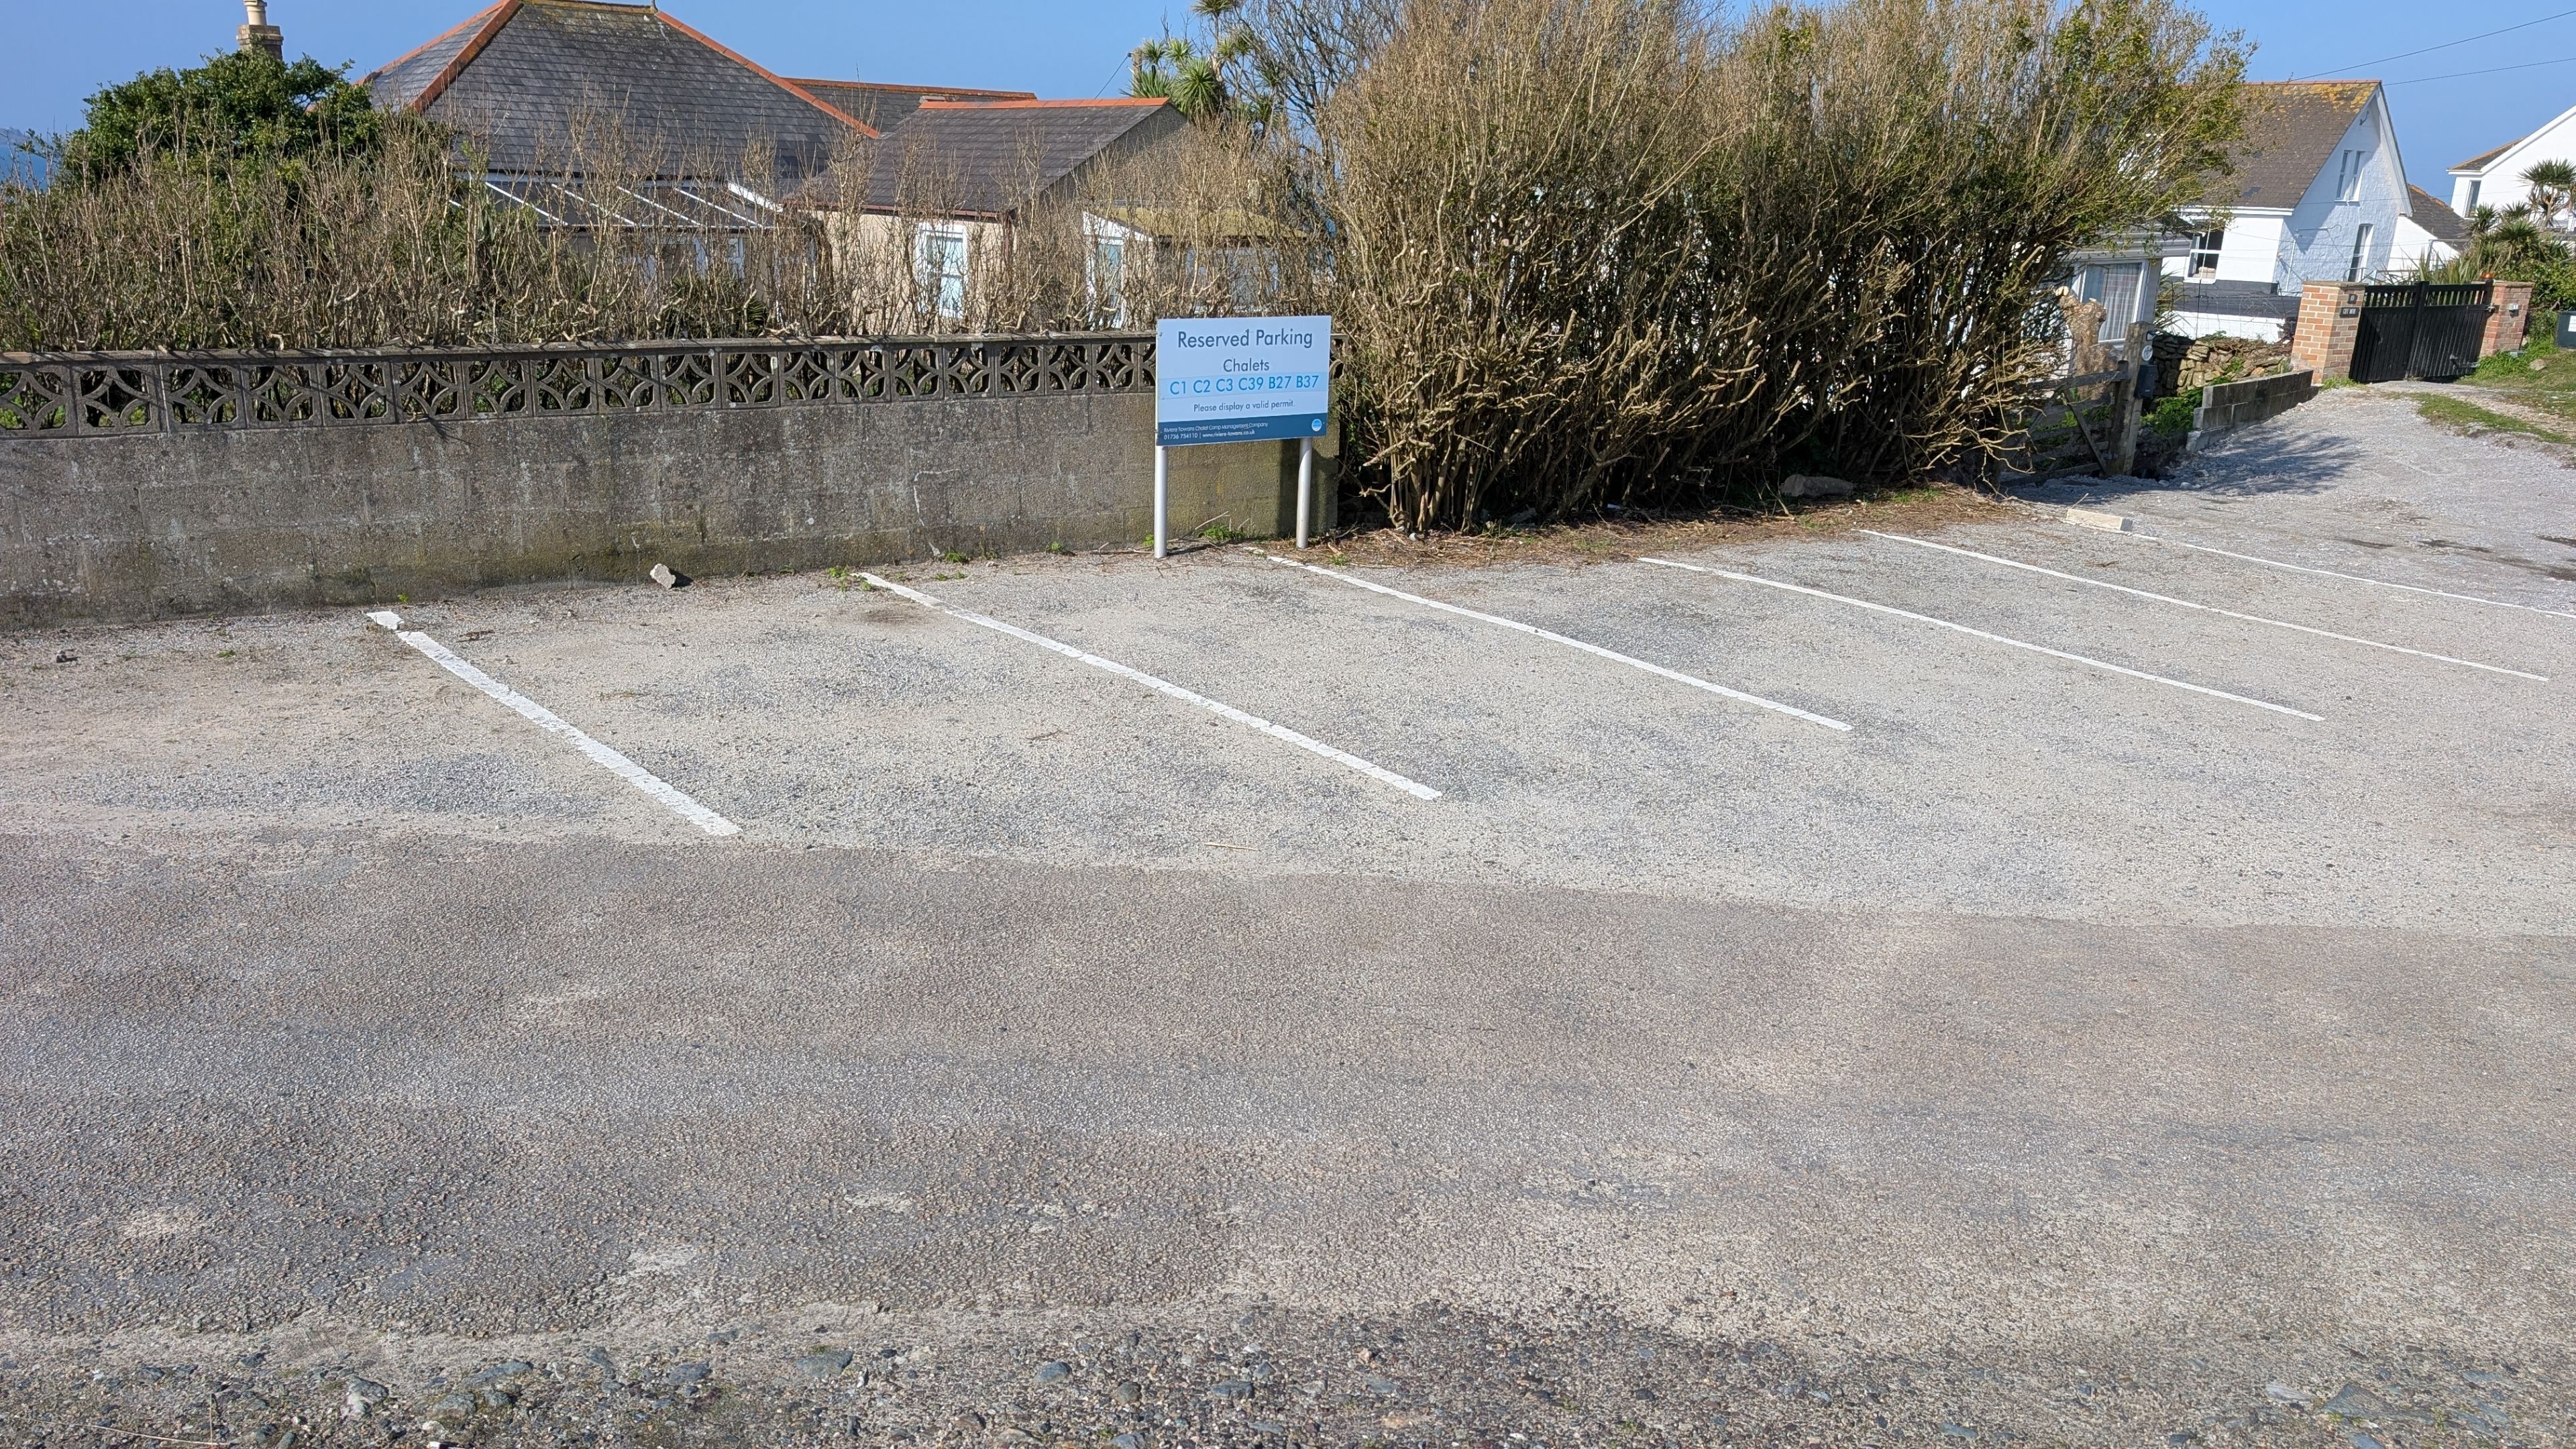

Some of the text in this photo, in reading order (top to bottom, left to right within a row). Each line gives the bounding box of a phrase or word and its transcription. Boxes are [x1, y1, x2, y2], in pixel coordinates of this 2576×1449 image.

[1178, 327, 1313, 348] Reserved Parking
[1223, 358, 1270, 372] Chalets
[1170, 375, 1320, 395] C1 C2 C3 C39 B27 B37
[1193, 403, 1217, 413] Please
[1218, 401, 1244, 412] display
[1252, 400, 1269, 409] valid
[1271, 399, 1295, 410] permit.
